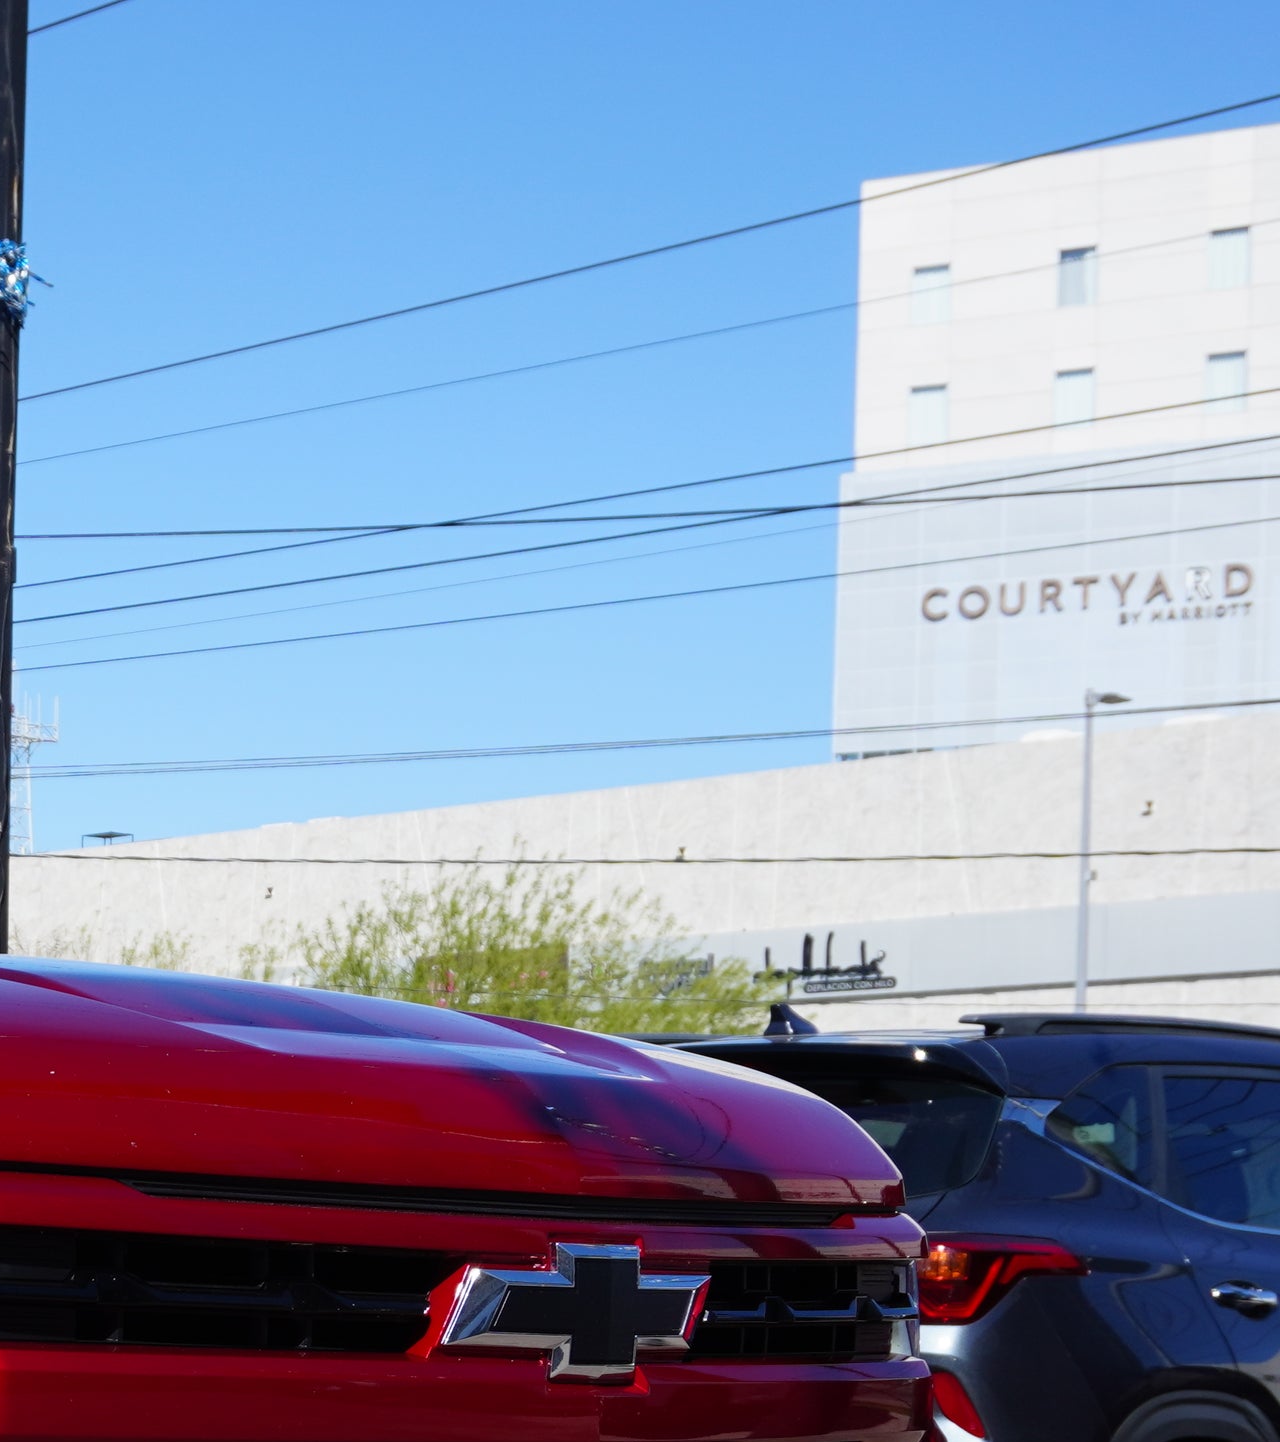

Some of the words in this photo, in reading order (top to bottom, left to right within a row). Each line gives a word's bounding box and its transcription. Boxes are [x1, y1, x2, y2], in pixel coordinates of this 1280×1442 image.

[921, 563, 1254, 622] COURTYARD
[1119, 611, 1141, 625] BY
[1150, 602, 1253, 622] MARRIOTT
